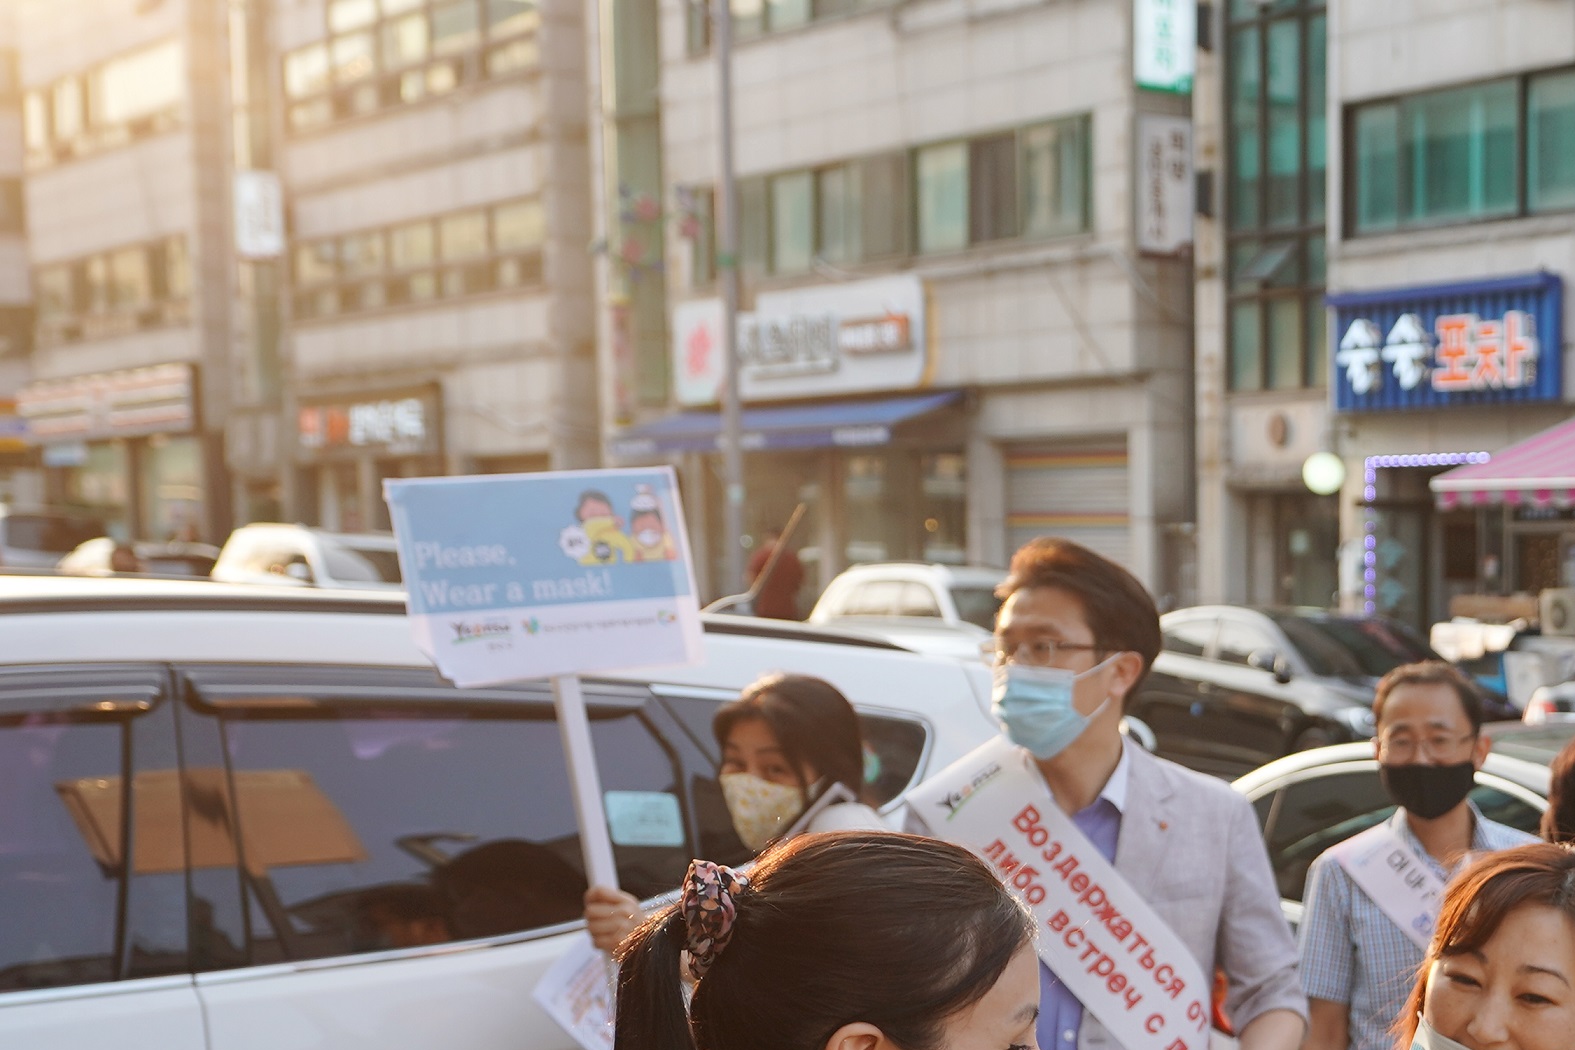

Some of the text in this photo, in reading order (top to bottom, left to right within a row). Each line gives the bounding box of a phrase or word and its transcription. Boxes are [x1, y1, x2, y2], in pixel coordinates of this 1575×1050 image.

[420, 570, 614, 607] Wear a mask!
[981, 838, 1047, 905] либо
[1048, 911, 1143, 1010] встреч
[1144, 1012, 1165, 1034] с
[1011, 804, 1208, 1032] Воздержаться от
